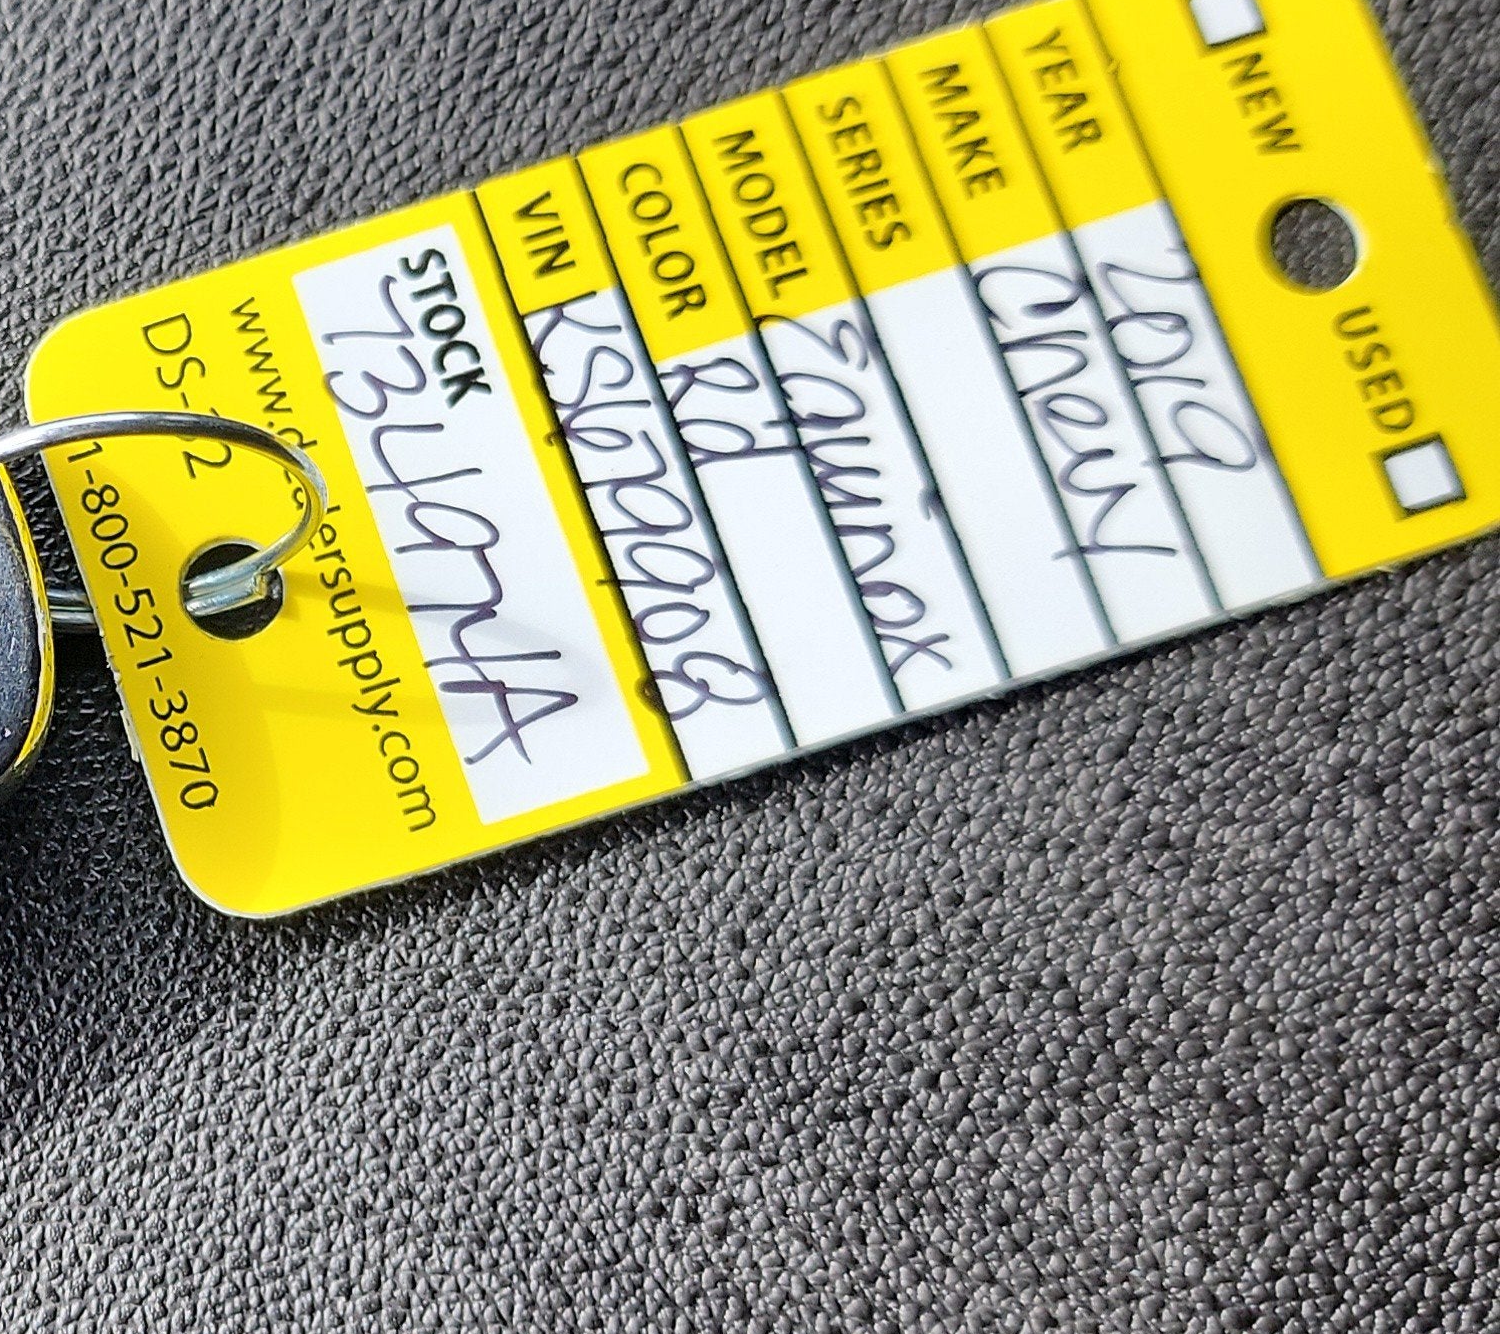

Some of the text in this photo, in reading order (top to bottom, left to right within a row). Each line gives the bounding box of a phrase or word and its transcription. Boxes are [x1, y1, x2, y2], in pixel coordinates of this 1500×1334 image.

[918, 62, 1007, 202] MAKE
[1023, 28, 1104, 155] YEAR
[1220, 51, 1304, 158] NEW
[515, 191, 577, 278] VIN
[619, 162, 708, 322] COLOR
[713, 130, 809, 301] MODEL
[817, 96, 913, 252] SERIES
[399, 247, 493, 408] STOCK
[1097, 245, 1258, 473] 2019
[1331, 304, 1418, 436] USED
[658, 356, 807, 470] Rd
[230, 295, 437, 833] www.dersupply.com
[322, 274, 578, 765] 734974A
[754, 313, 953, 677] Equinox
[65, 440, 219, 811] 1-800-521-3870
